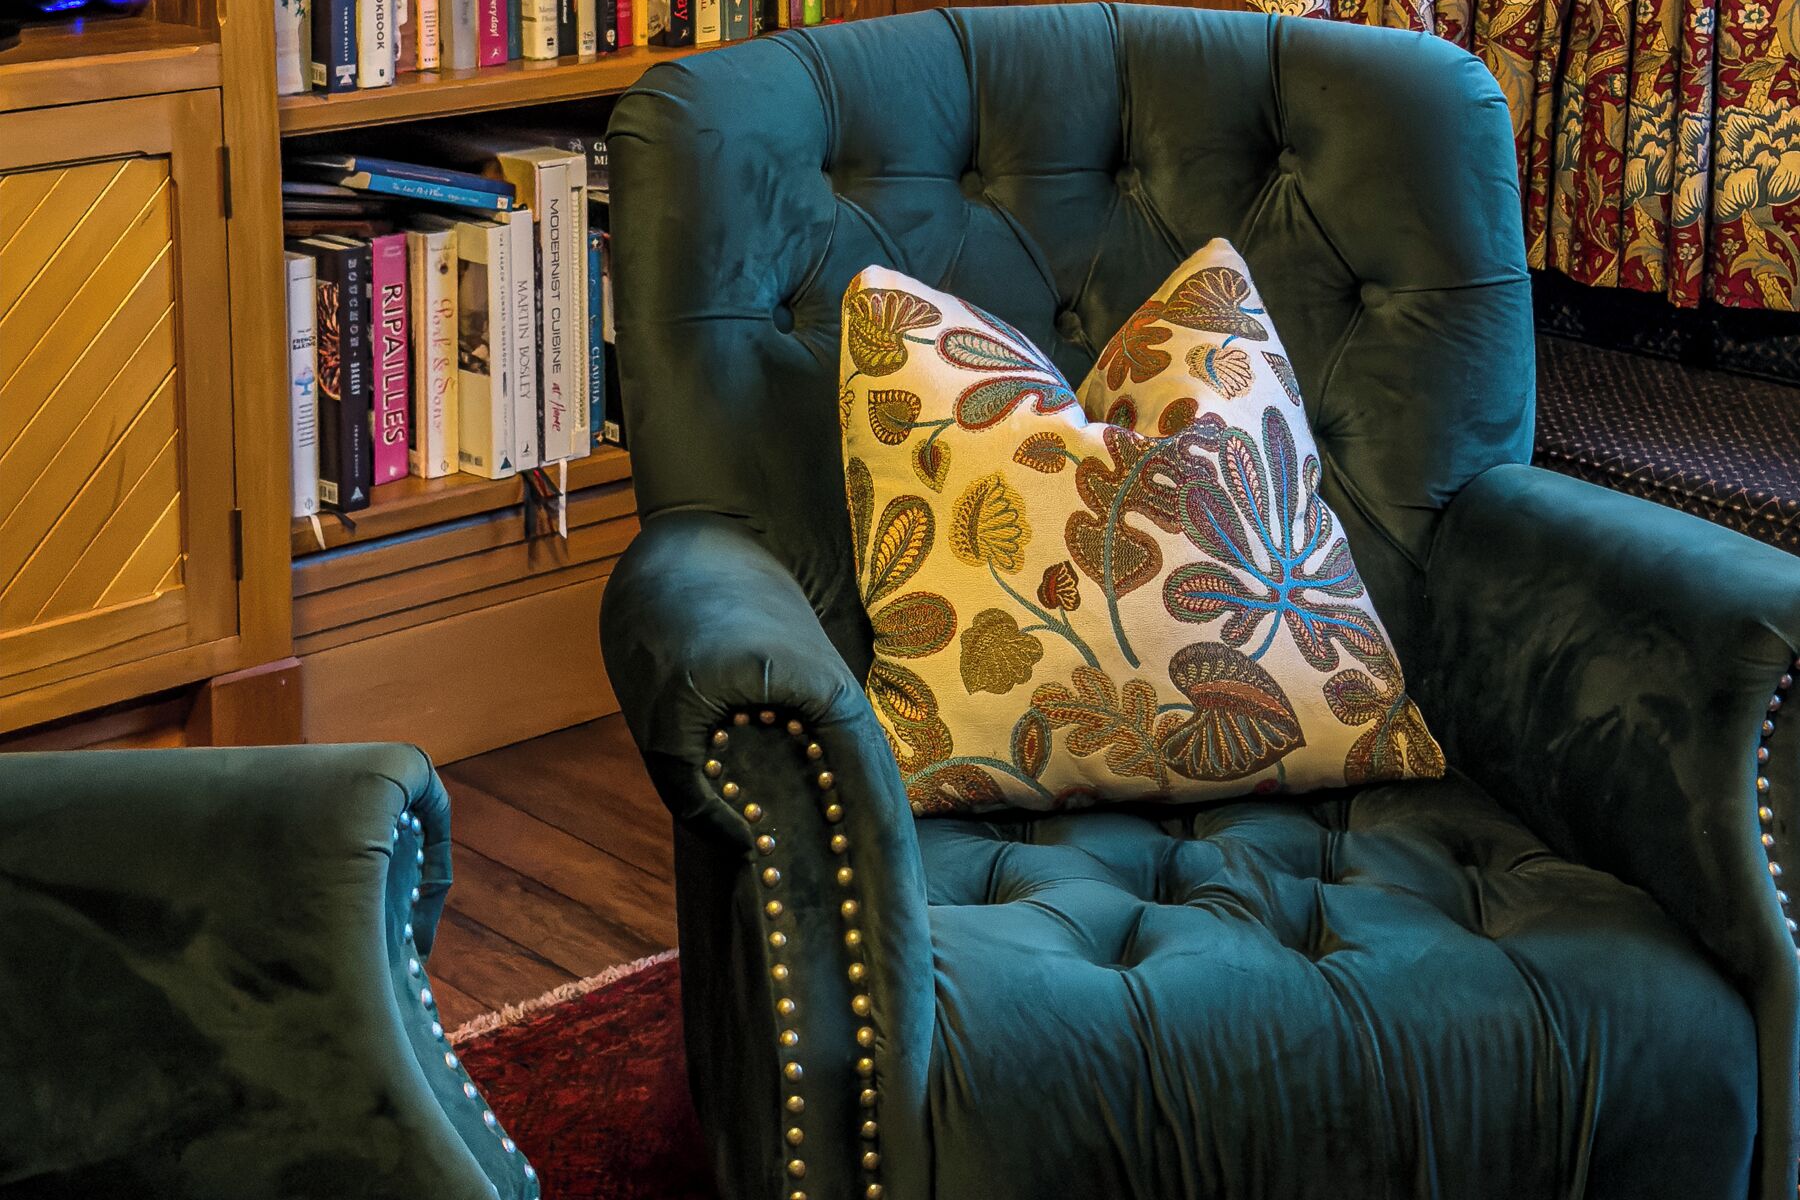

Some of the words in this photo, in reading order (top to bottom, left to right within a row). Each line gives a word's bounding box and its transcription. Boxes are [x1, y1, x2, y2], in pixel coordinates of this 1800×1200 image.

[550, 199, 560, 301] MODERNIST
[432, 299, 452, 346] Pork
[516, 280, 530, 339] MARTIN
[381, 282, 405, 445] RIPAILLES
[434, 351, 447, 370] &
[552, 307, 562, 374] CUISINE
[350, 362, 360, 396] BAKERY
[518, 346, 530, 399] BOSLEY
[552, 382, 562, 397] at
[591, 346, 600, 404] CLAUDIA
